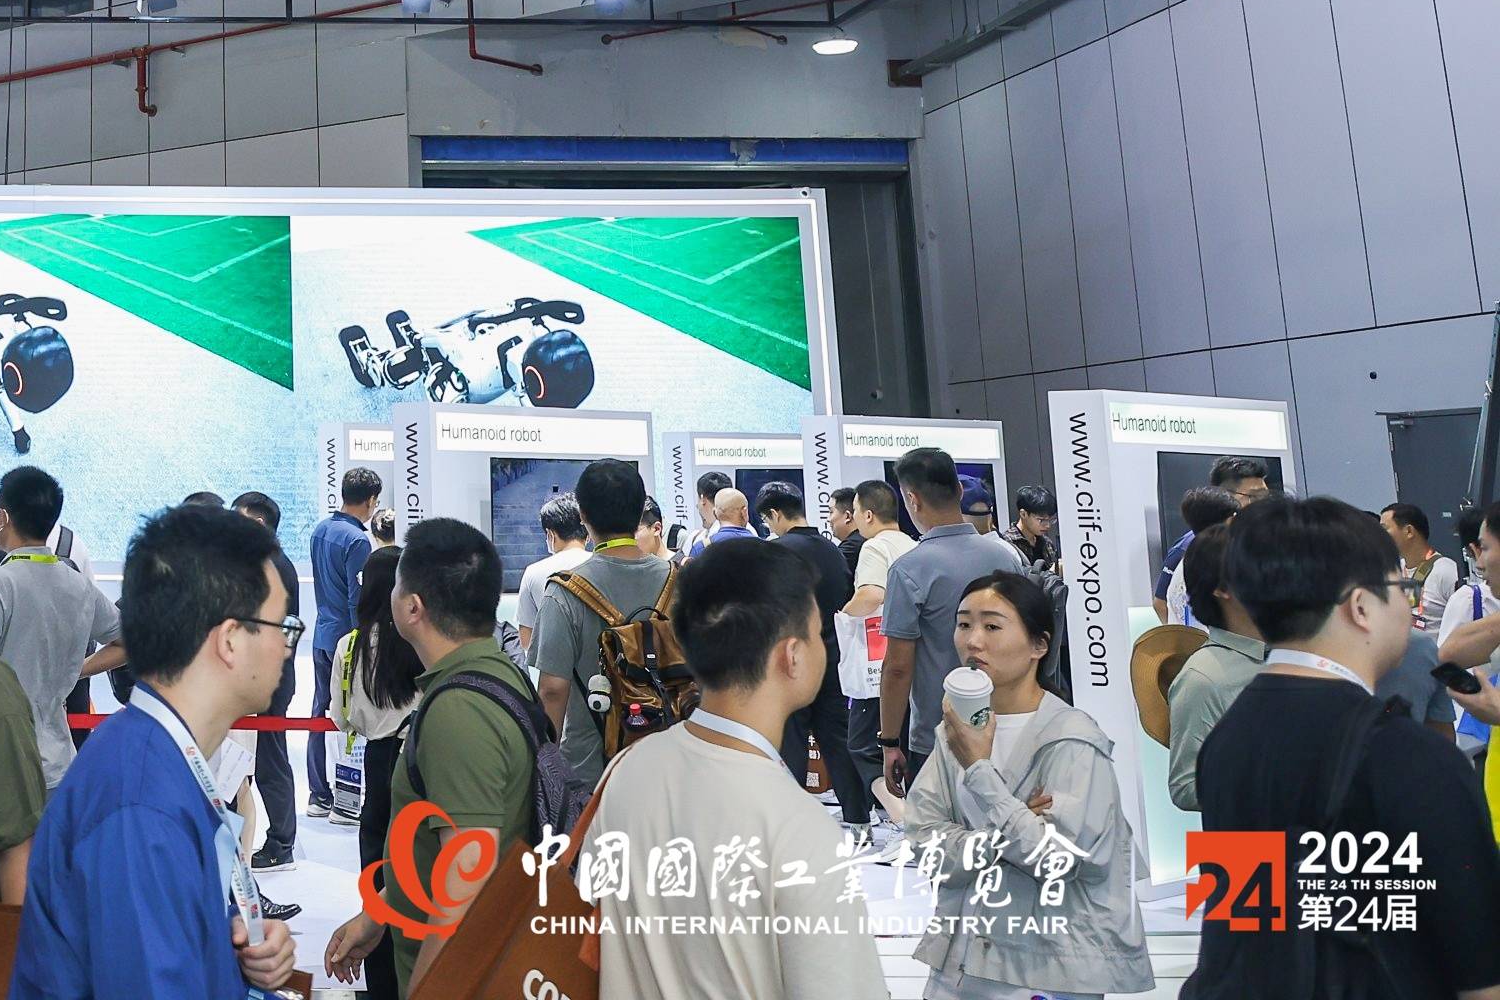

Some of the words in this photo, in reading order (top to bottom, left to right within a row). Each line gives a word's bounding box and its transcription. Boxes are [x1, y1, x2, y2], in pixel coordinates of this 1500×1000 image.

[441, 423, 506, 441] Humanoid
[510, 427, 542, 442] robot
[1112, 412, 1167, 433] Humanoid
[1169, 417, 1196, 435] robot
[846, 432, 893, 447] Humanoid
[896, 435, 919, 447] robot
[698, 446, 741, 457] Humanoid
[744, 447, 767, 458] robot
[1069, 412, 1109, 687] www.ciif-expo.com
[523, 968, 572, 1000] CO
